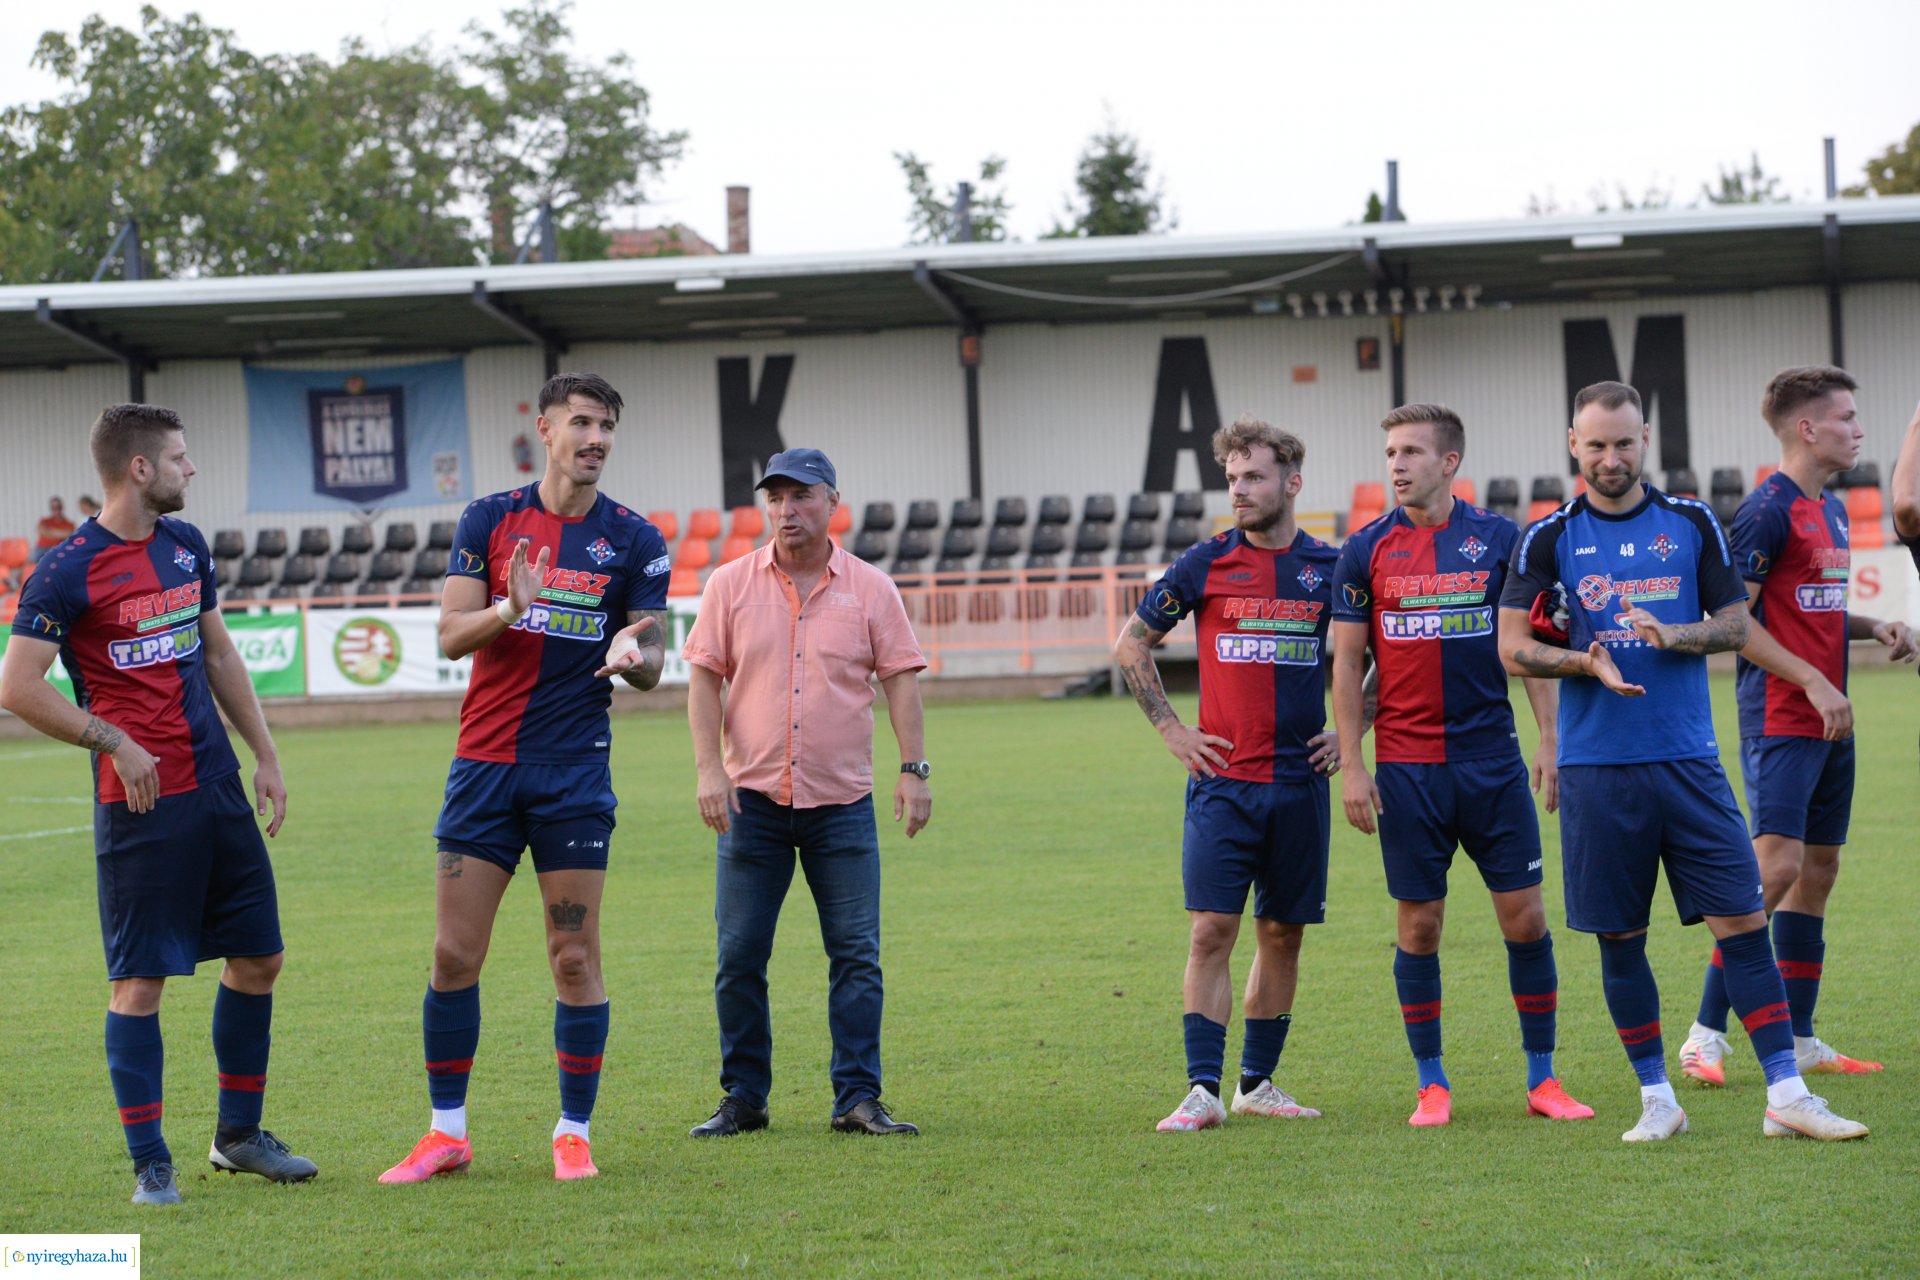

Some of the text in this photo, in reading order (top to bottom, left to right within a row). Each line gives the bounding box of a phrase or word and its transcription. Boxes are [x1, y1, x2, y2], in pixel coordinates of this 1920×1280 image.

[717, 354, 796, 511] K
[1142, 335, 1235, 493] A
[1575, 543, 1635, 557] JAKO 48
[500, 560, 611, 596] VESZ
[1384, 571, 1491, 598] REVESZ
[1612, 576, 1681, 596] REVESZ
[119, 580, 202, 624] REVESZ
[551, 591, 563, 599] THE
[564, 594, 583, 602] RIGHT
[494, 598, 602, 636] PMIX
[1223, 598, 1324, 622] REVESZ
[1240, 620, 1264, 628] ALWAYS
[582, 840, 604, 849] JAKO
[1528, 857, 1542, 871] JAK
